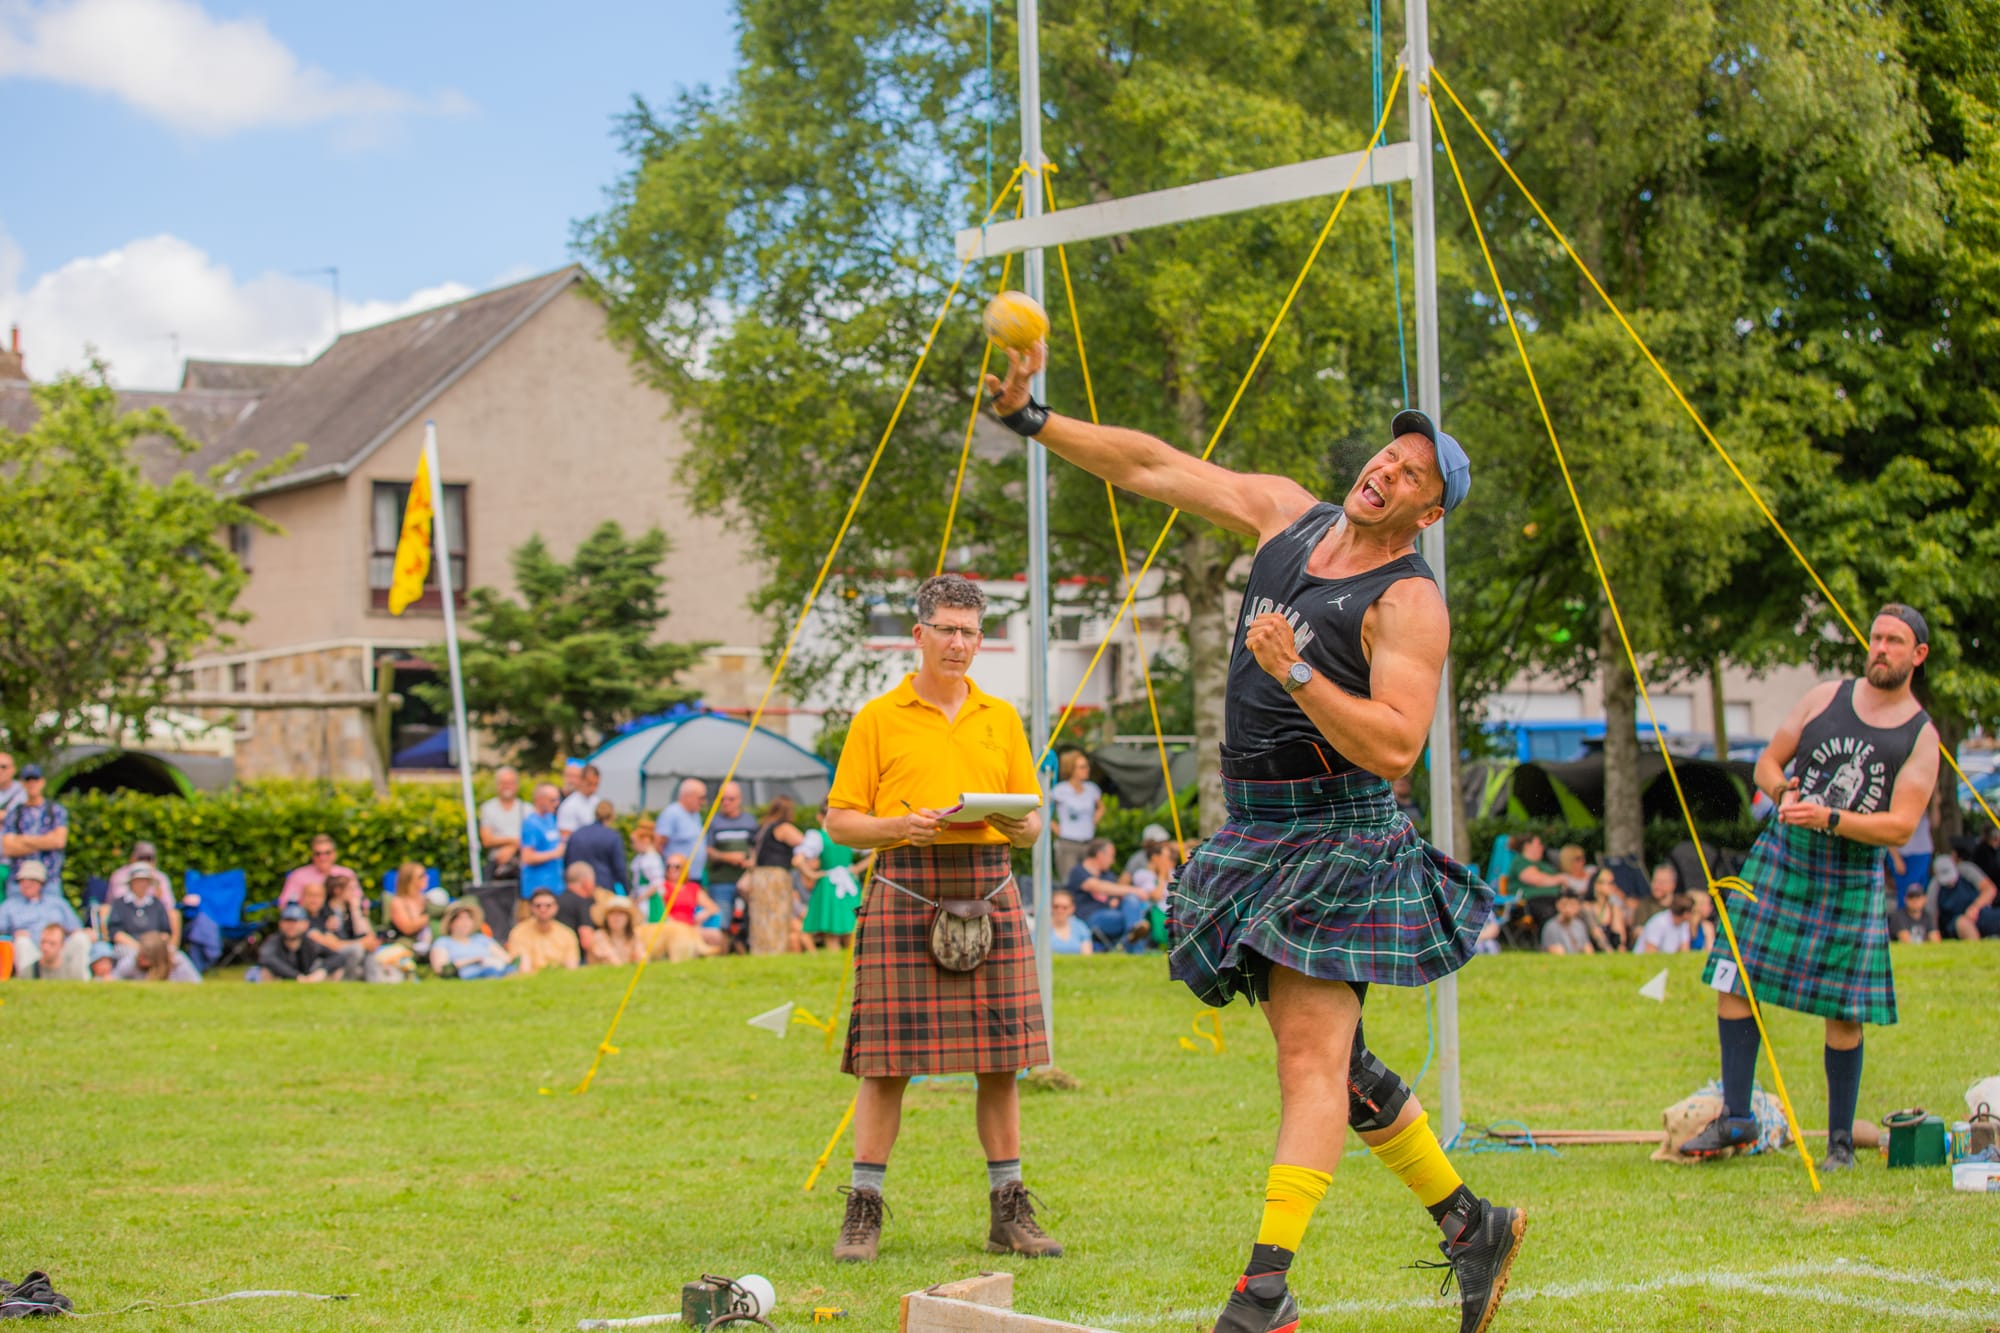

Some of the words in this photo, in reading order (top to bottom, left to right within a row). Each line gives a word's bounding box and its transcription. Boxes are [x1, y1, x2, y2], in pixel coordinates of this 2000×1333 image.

[1245, 596, 1315, 655] JON
[1800, 766, 1820, 795] THE
[1812, 737, 1875, 765] DINNIE
[1719, 967, 1729, 980] 7
